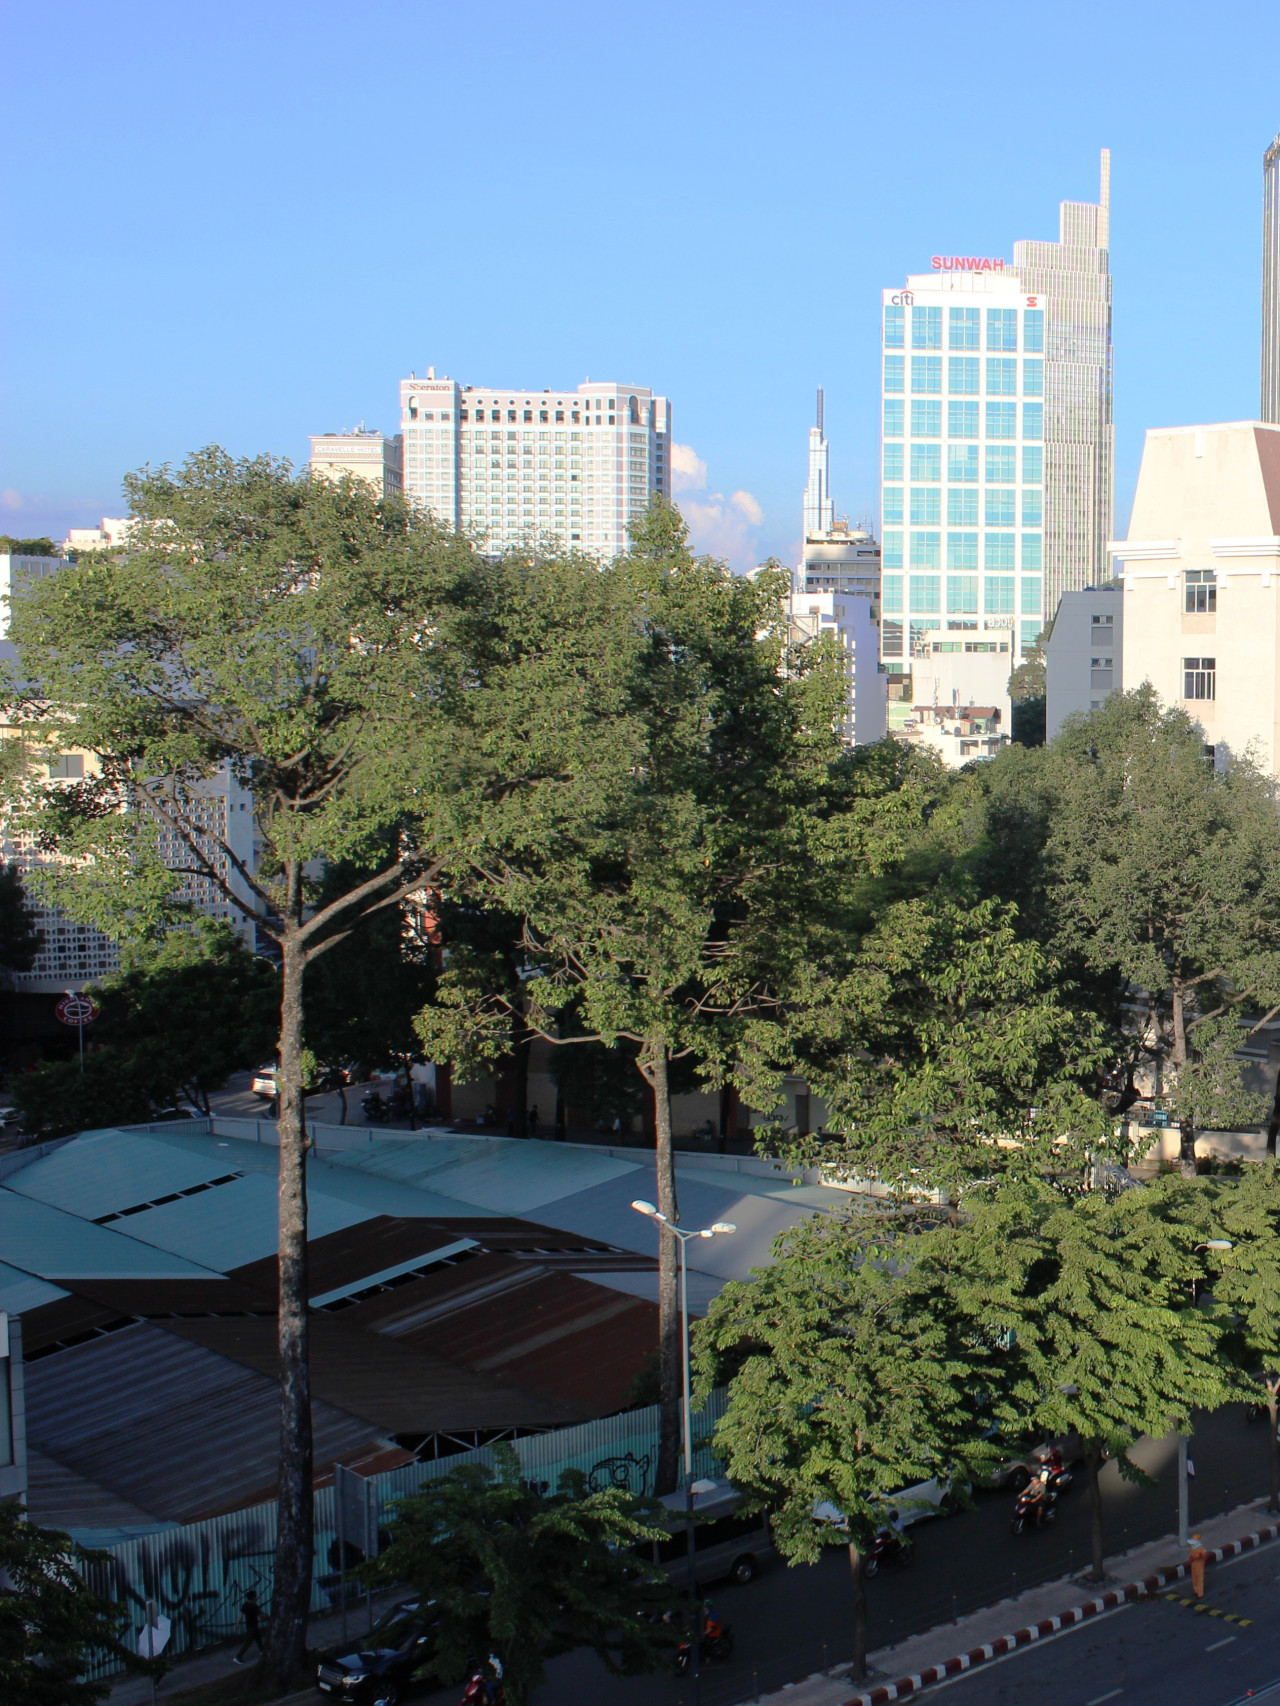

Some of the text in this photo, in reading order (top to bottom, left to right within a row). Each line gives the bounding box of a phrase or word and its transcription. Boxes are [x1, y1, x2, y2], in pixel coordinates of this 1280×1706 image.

[931, 256, 1004, 271] SUNWAH
[891, 292, 914, 306] citi
[409, 383, 450, 391] Sheraton
[63, 1015, 93, 1024] COFEE
